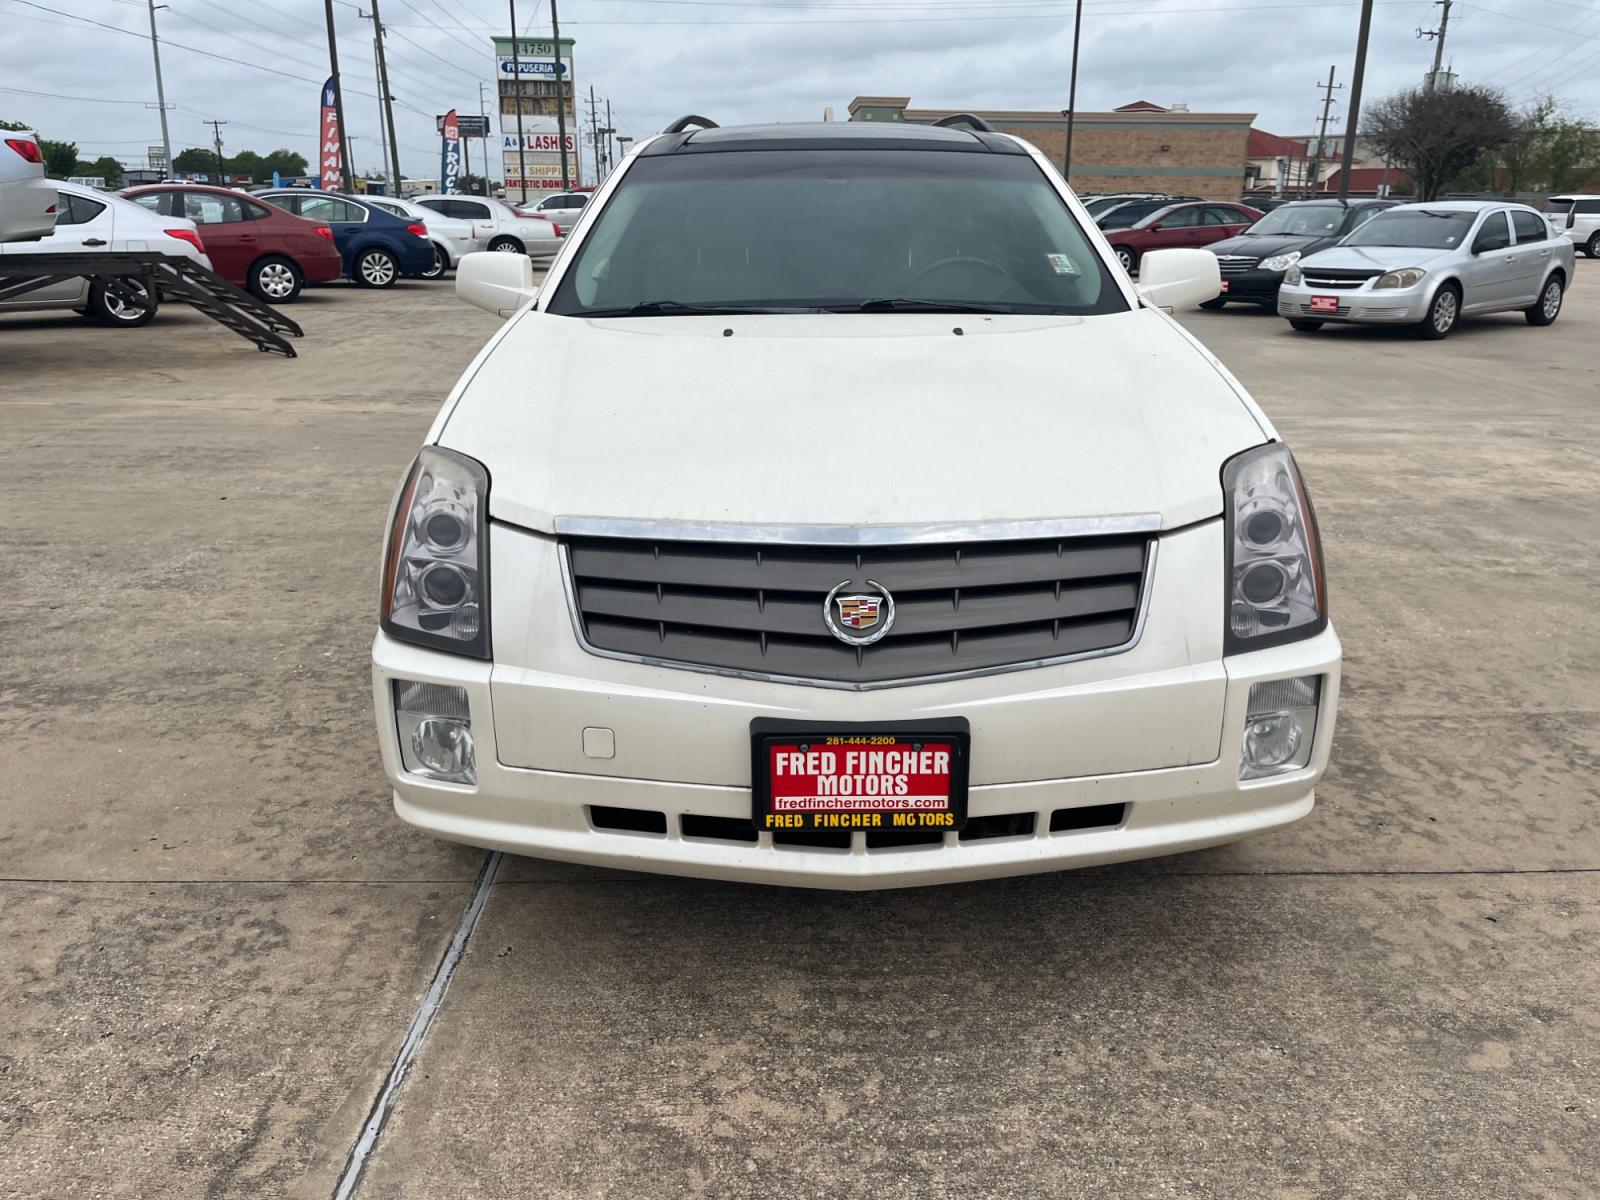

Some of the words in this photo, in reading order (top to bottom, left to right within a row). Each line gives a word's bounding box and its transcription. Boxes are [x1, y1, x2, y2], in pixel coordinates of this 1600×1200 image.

[527, 135, 574, 150] LASHS
[528, 166, 576, 175] SHIPPIG
[505, 179, 541, 189] FANTSTIC
[826, 736, 896, 745] 281-444-2200
[775, 752, 837, 776] FRED
[846, 751, 950, 775] FINCHER
[816, 774, 909, 796] MOTORS
[777, 797, 946, 809] fredfinchermotors.com
[765, 814, 804, 828] FRED
[814, 813, 882, 828] FINCHER
[893, 812, 955, 827] MOTORS
